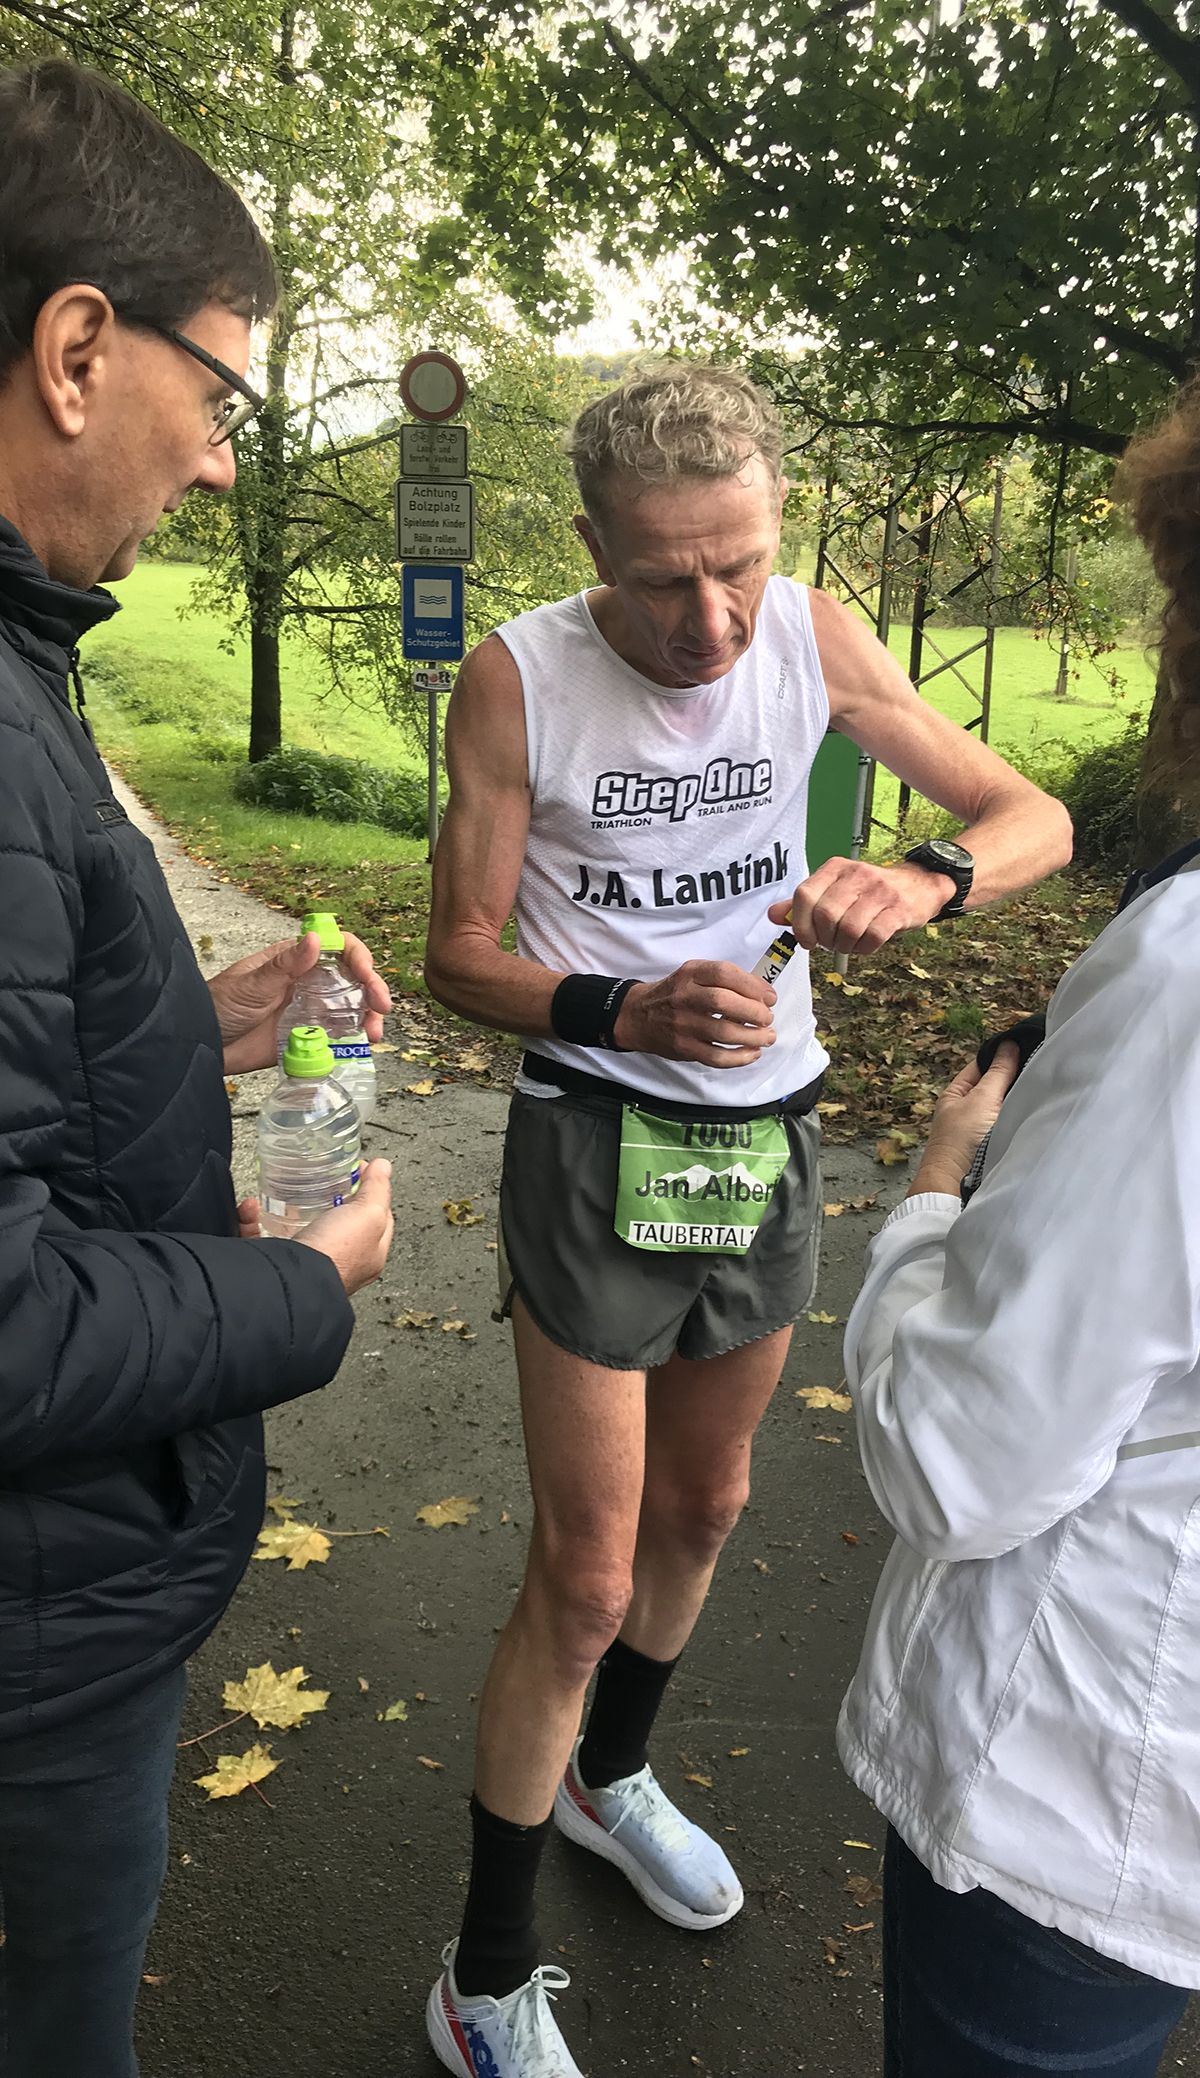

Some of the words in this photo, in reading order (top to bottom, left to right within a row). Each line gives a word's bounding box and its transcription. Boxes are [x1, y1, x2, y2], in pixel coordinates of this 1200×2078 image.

[412, 486, 458, 500] Achtung
[409, 500, 461, 514] Bolzplatz
[403, 517, 440, 528] Spielende
[442, 519, 466, 528] Kinder
[434, 534, 457, 543] rollen
[403, 545, 416, 554] auf
[418, 545, 431, 554] die
[433, 546, 467, 556] Fahrbahn
[415, 628, 452, 637] Wasser-
[406, 638, 461, 649] Schutzgebiet
[697, 807, 726, 817] TRAIL
[727, 801, 750, 813] AND
[753, 795, 772, 808] RUN
[590, 817, 652, 830] TRIATHLON
[572, 864, 642, 909] J.A.
[653, 841, 790, 907] Lantink
[635, 1170, 690, 1199] Jan
